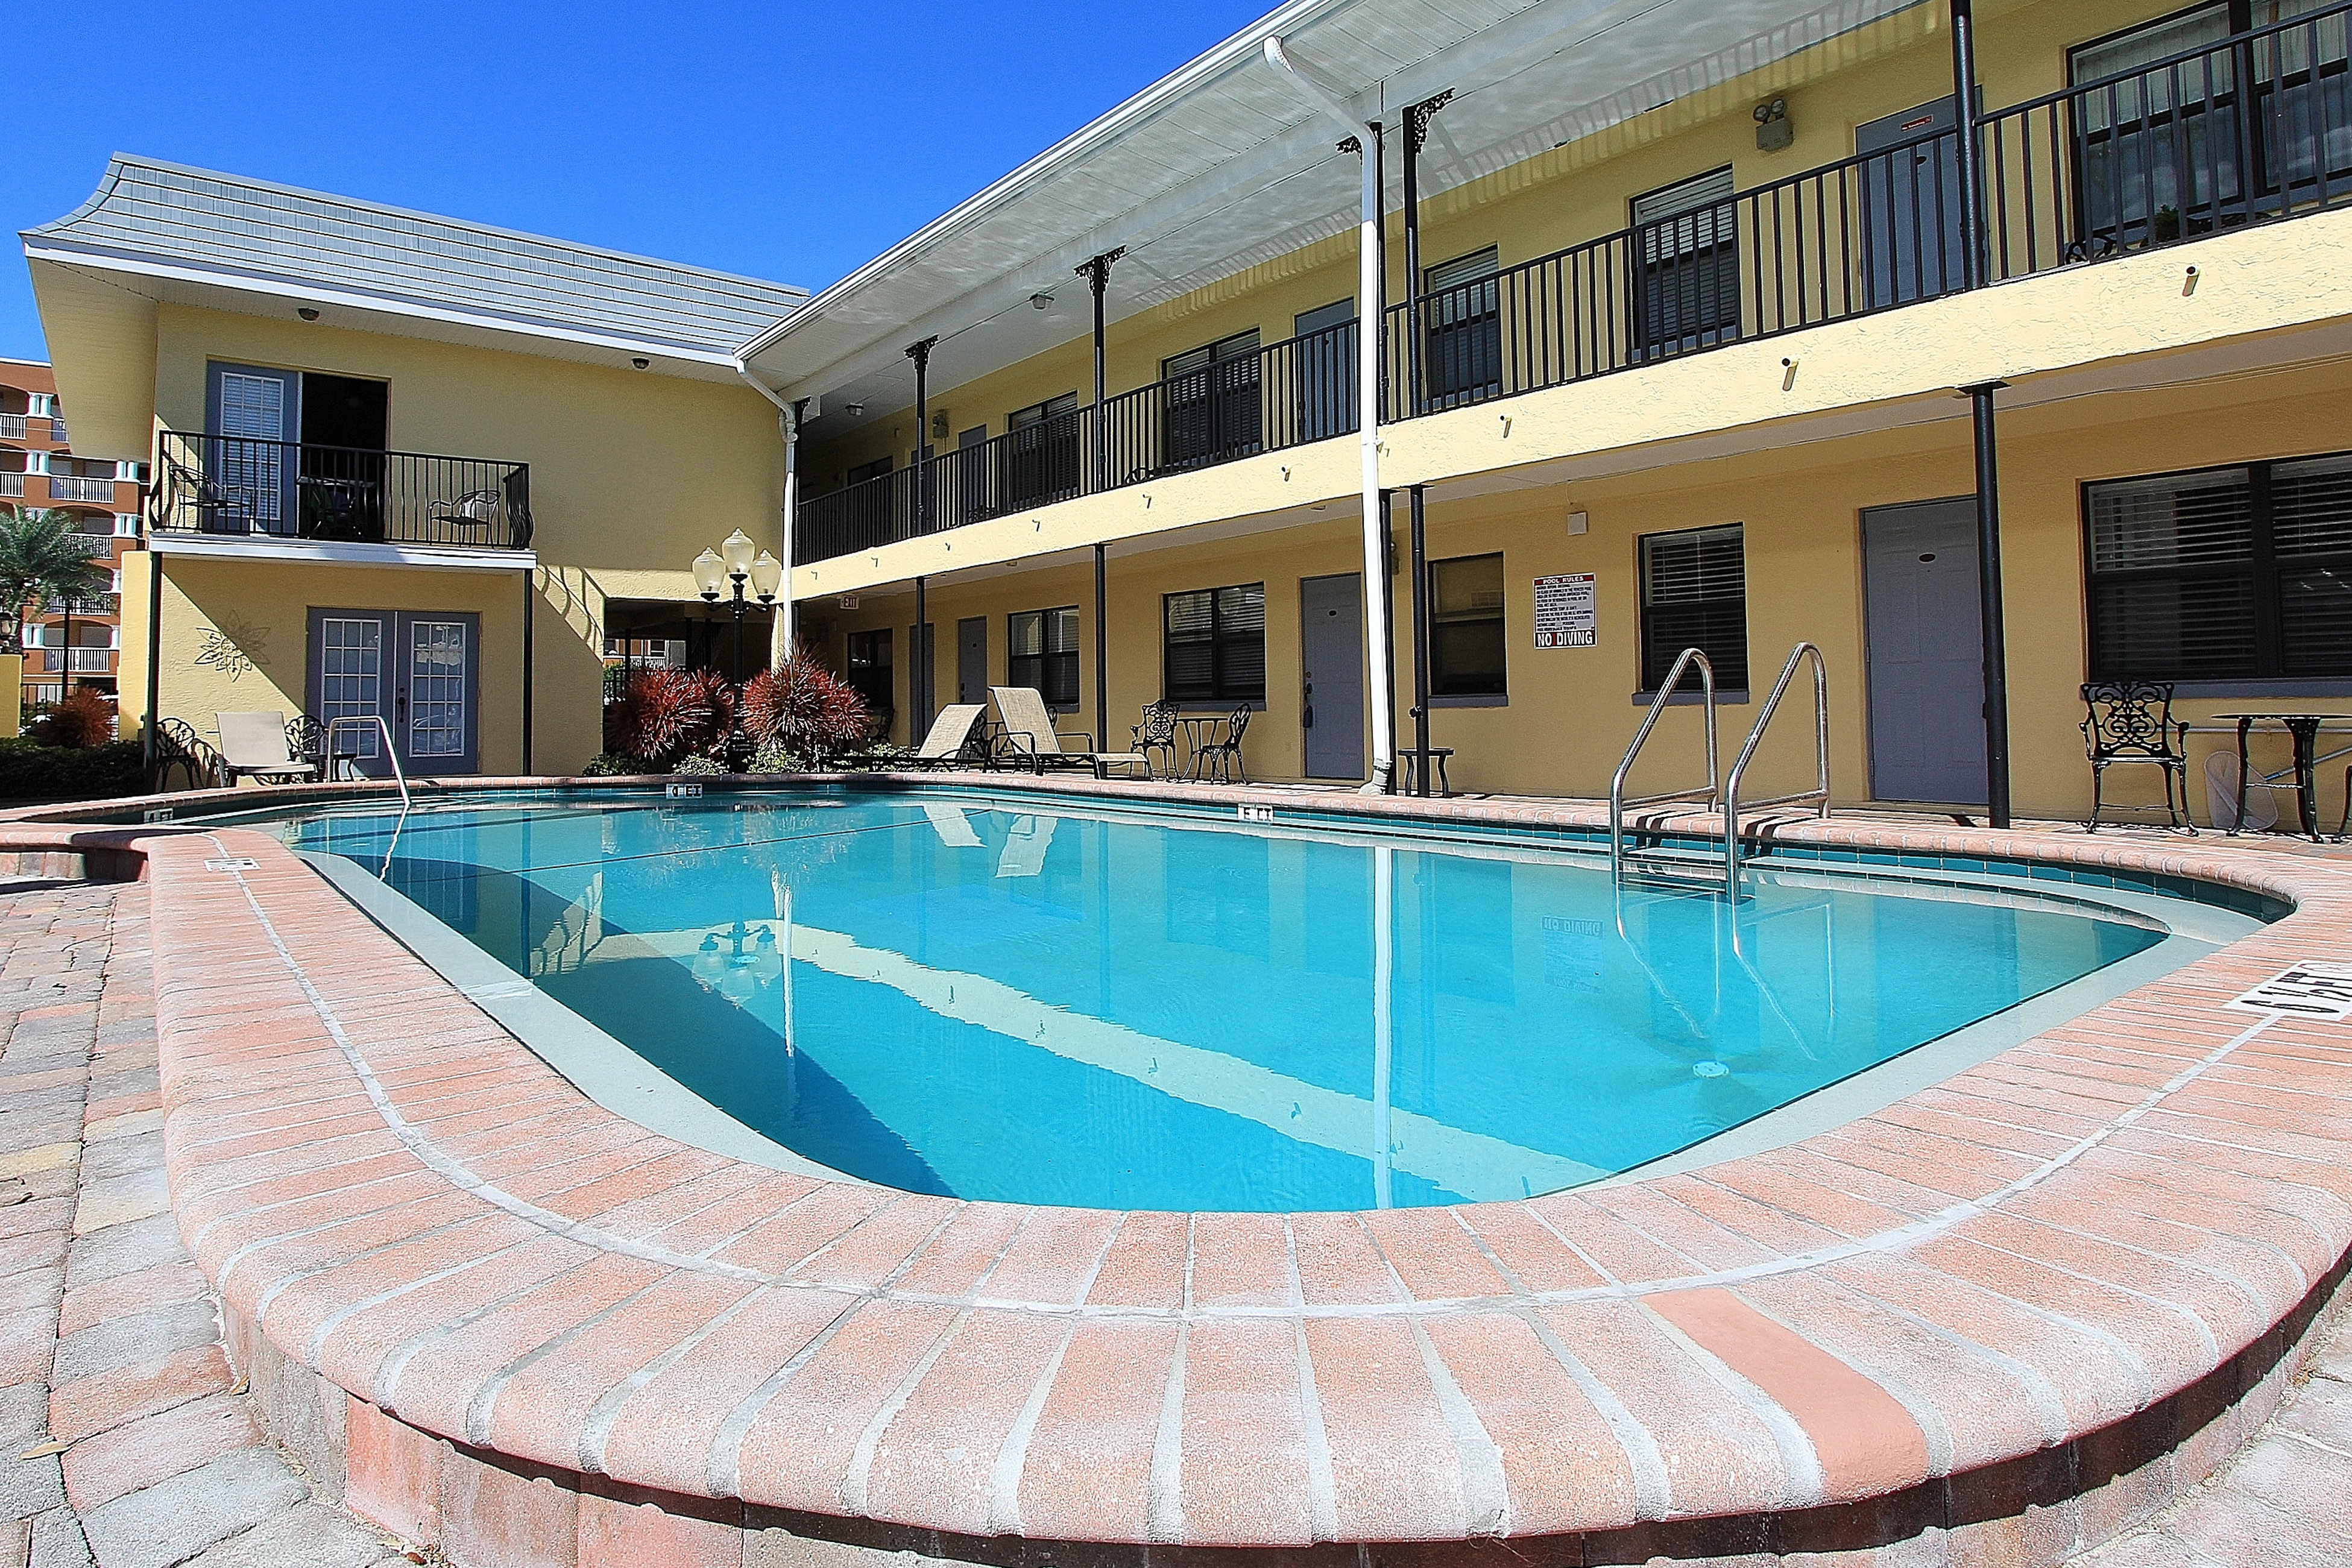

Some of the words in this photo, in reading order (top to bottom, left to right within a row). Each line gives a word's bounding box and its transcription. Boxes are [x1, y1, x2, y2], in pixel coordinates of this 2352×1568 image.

[844, 597, 857, 608] EXIT
[1537, 632, 1552, 646] NO
[1556, 631, 1593, 646] DIVING
